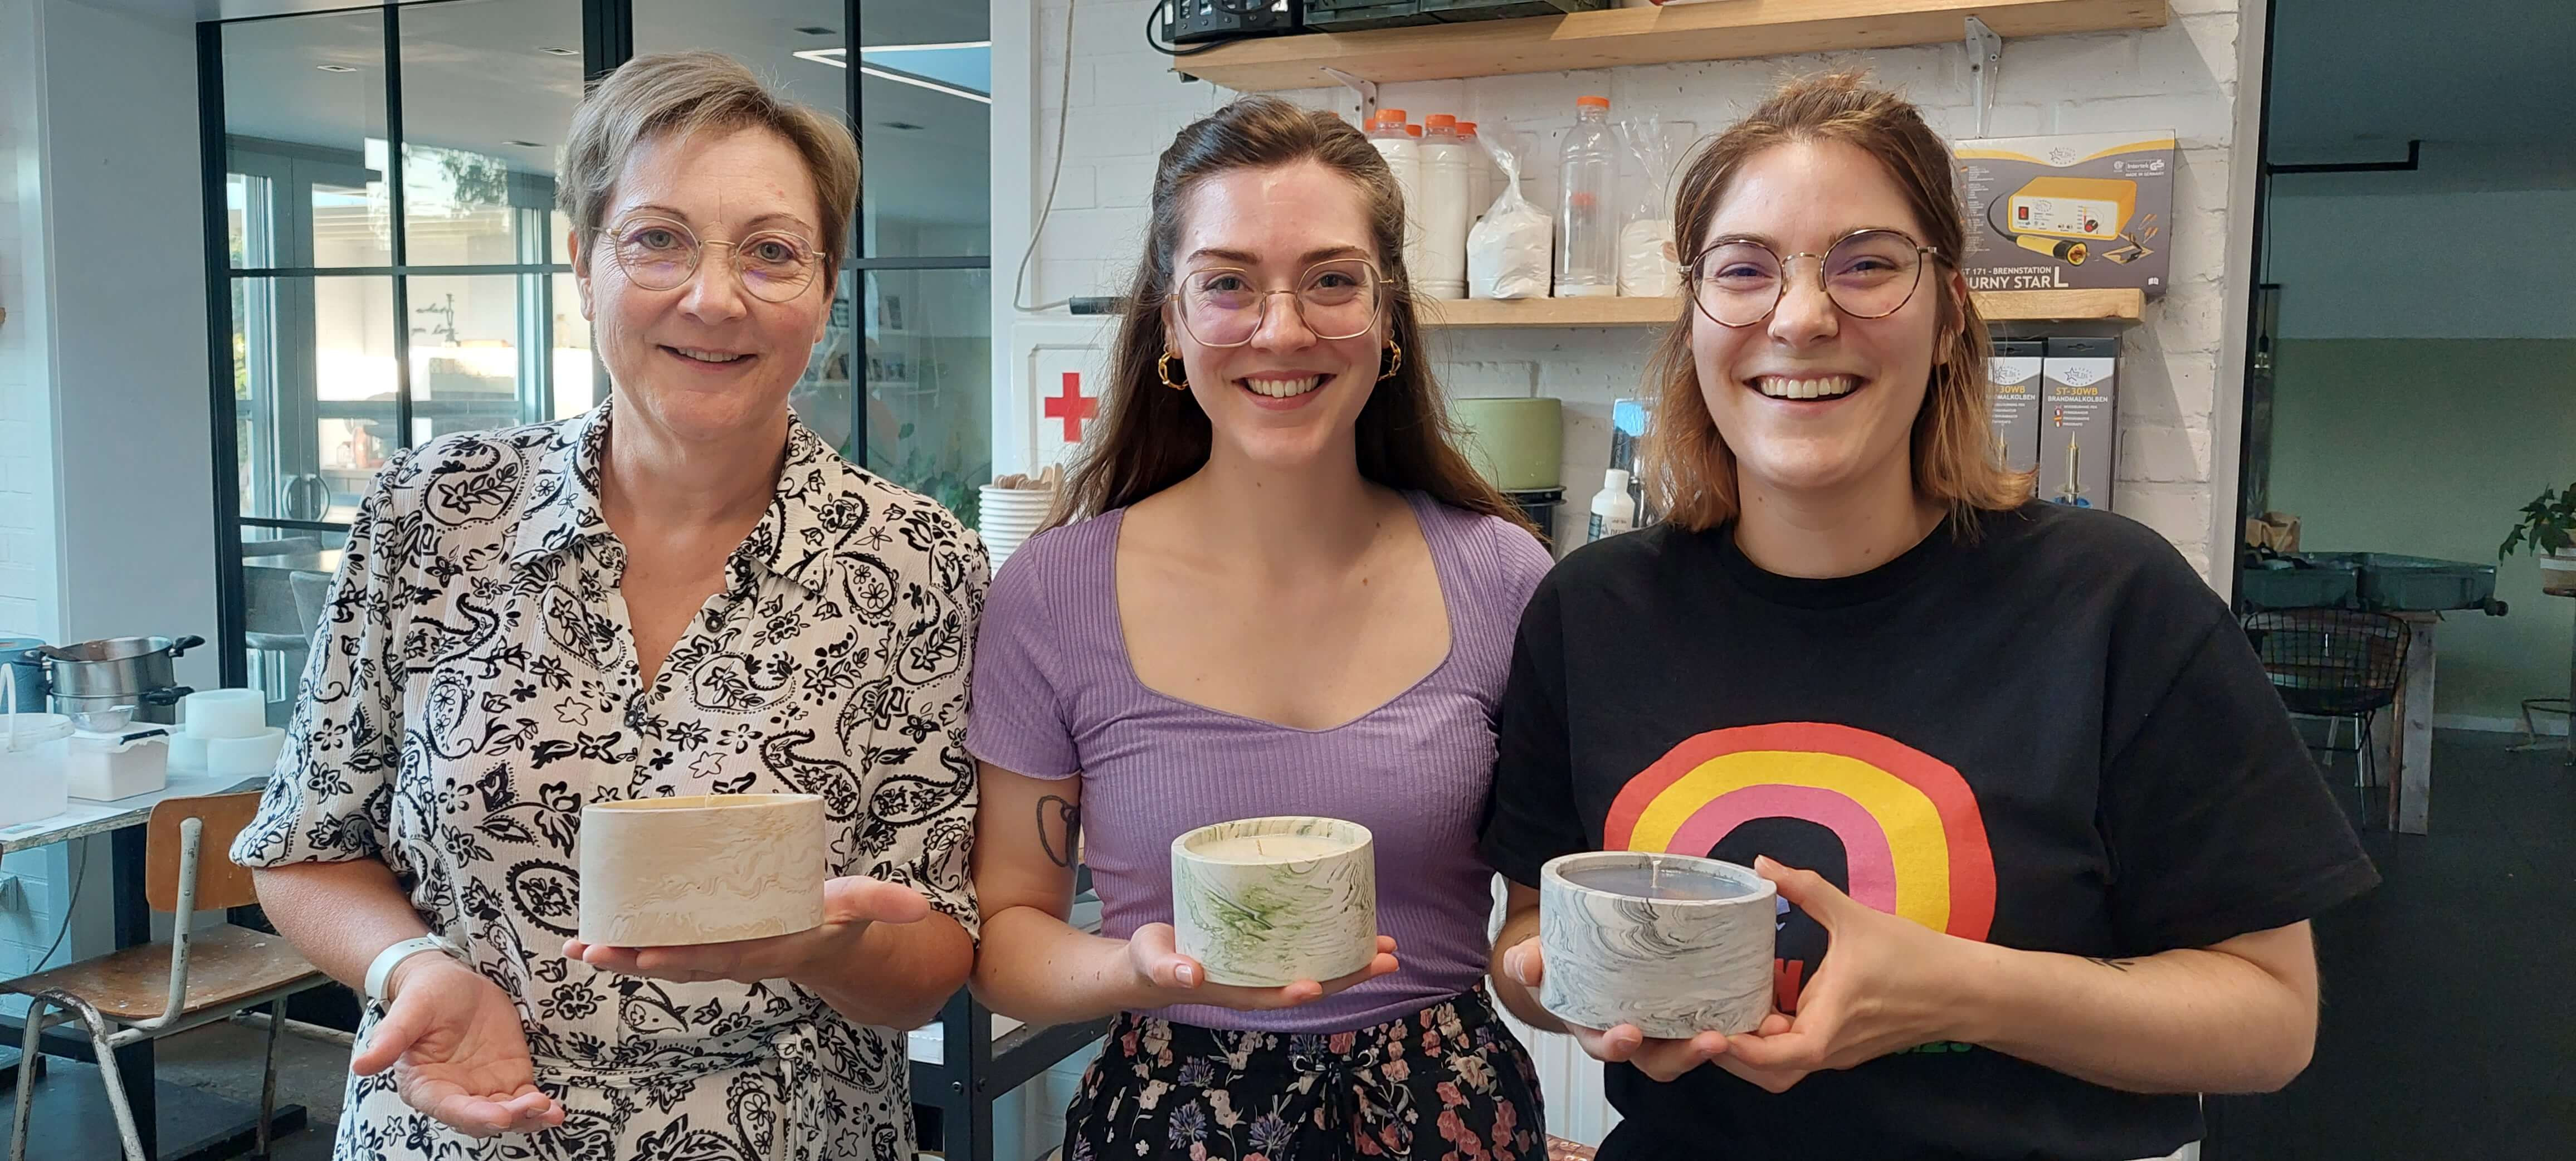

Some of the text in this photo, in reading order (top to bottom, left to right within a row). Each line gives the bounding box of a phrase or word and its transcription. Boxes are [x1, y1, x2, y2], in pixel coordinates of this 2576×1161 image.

[1993, 266, 2052, 275] BRENNSTATION
[1967, 266, 2069, 289] URNY STAR L
[2056, 387, 2098, 396] ST-30WB
